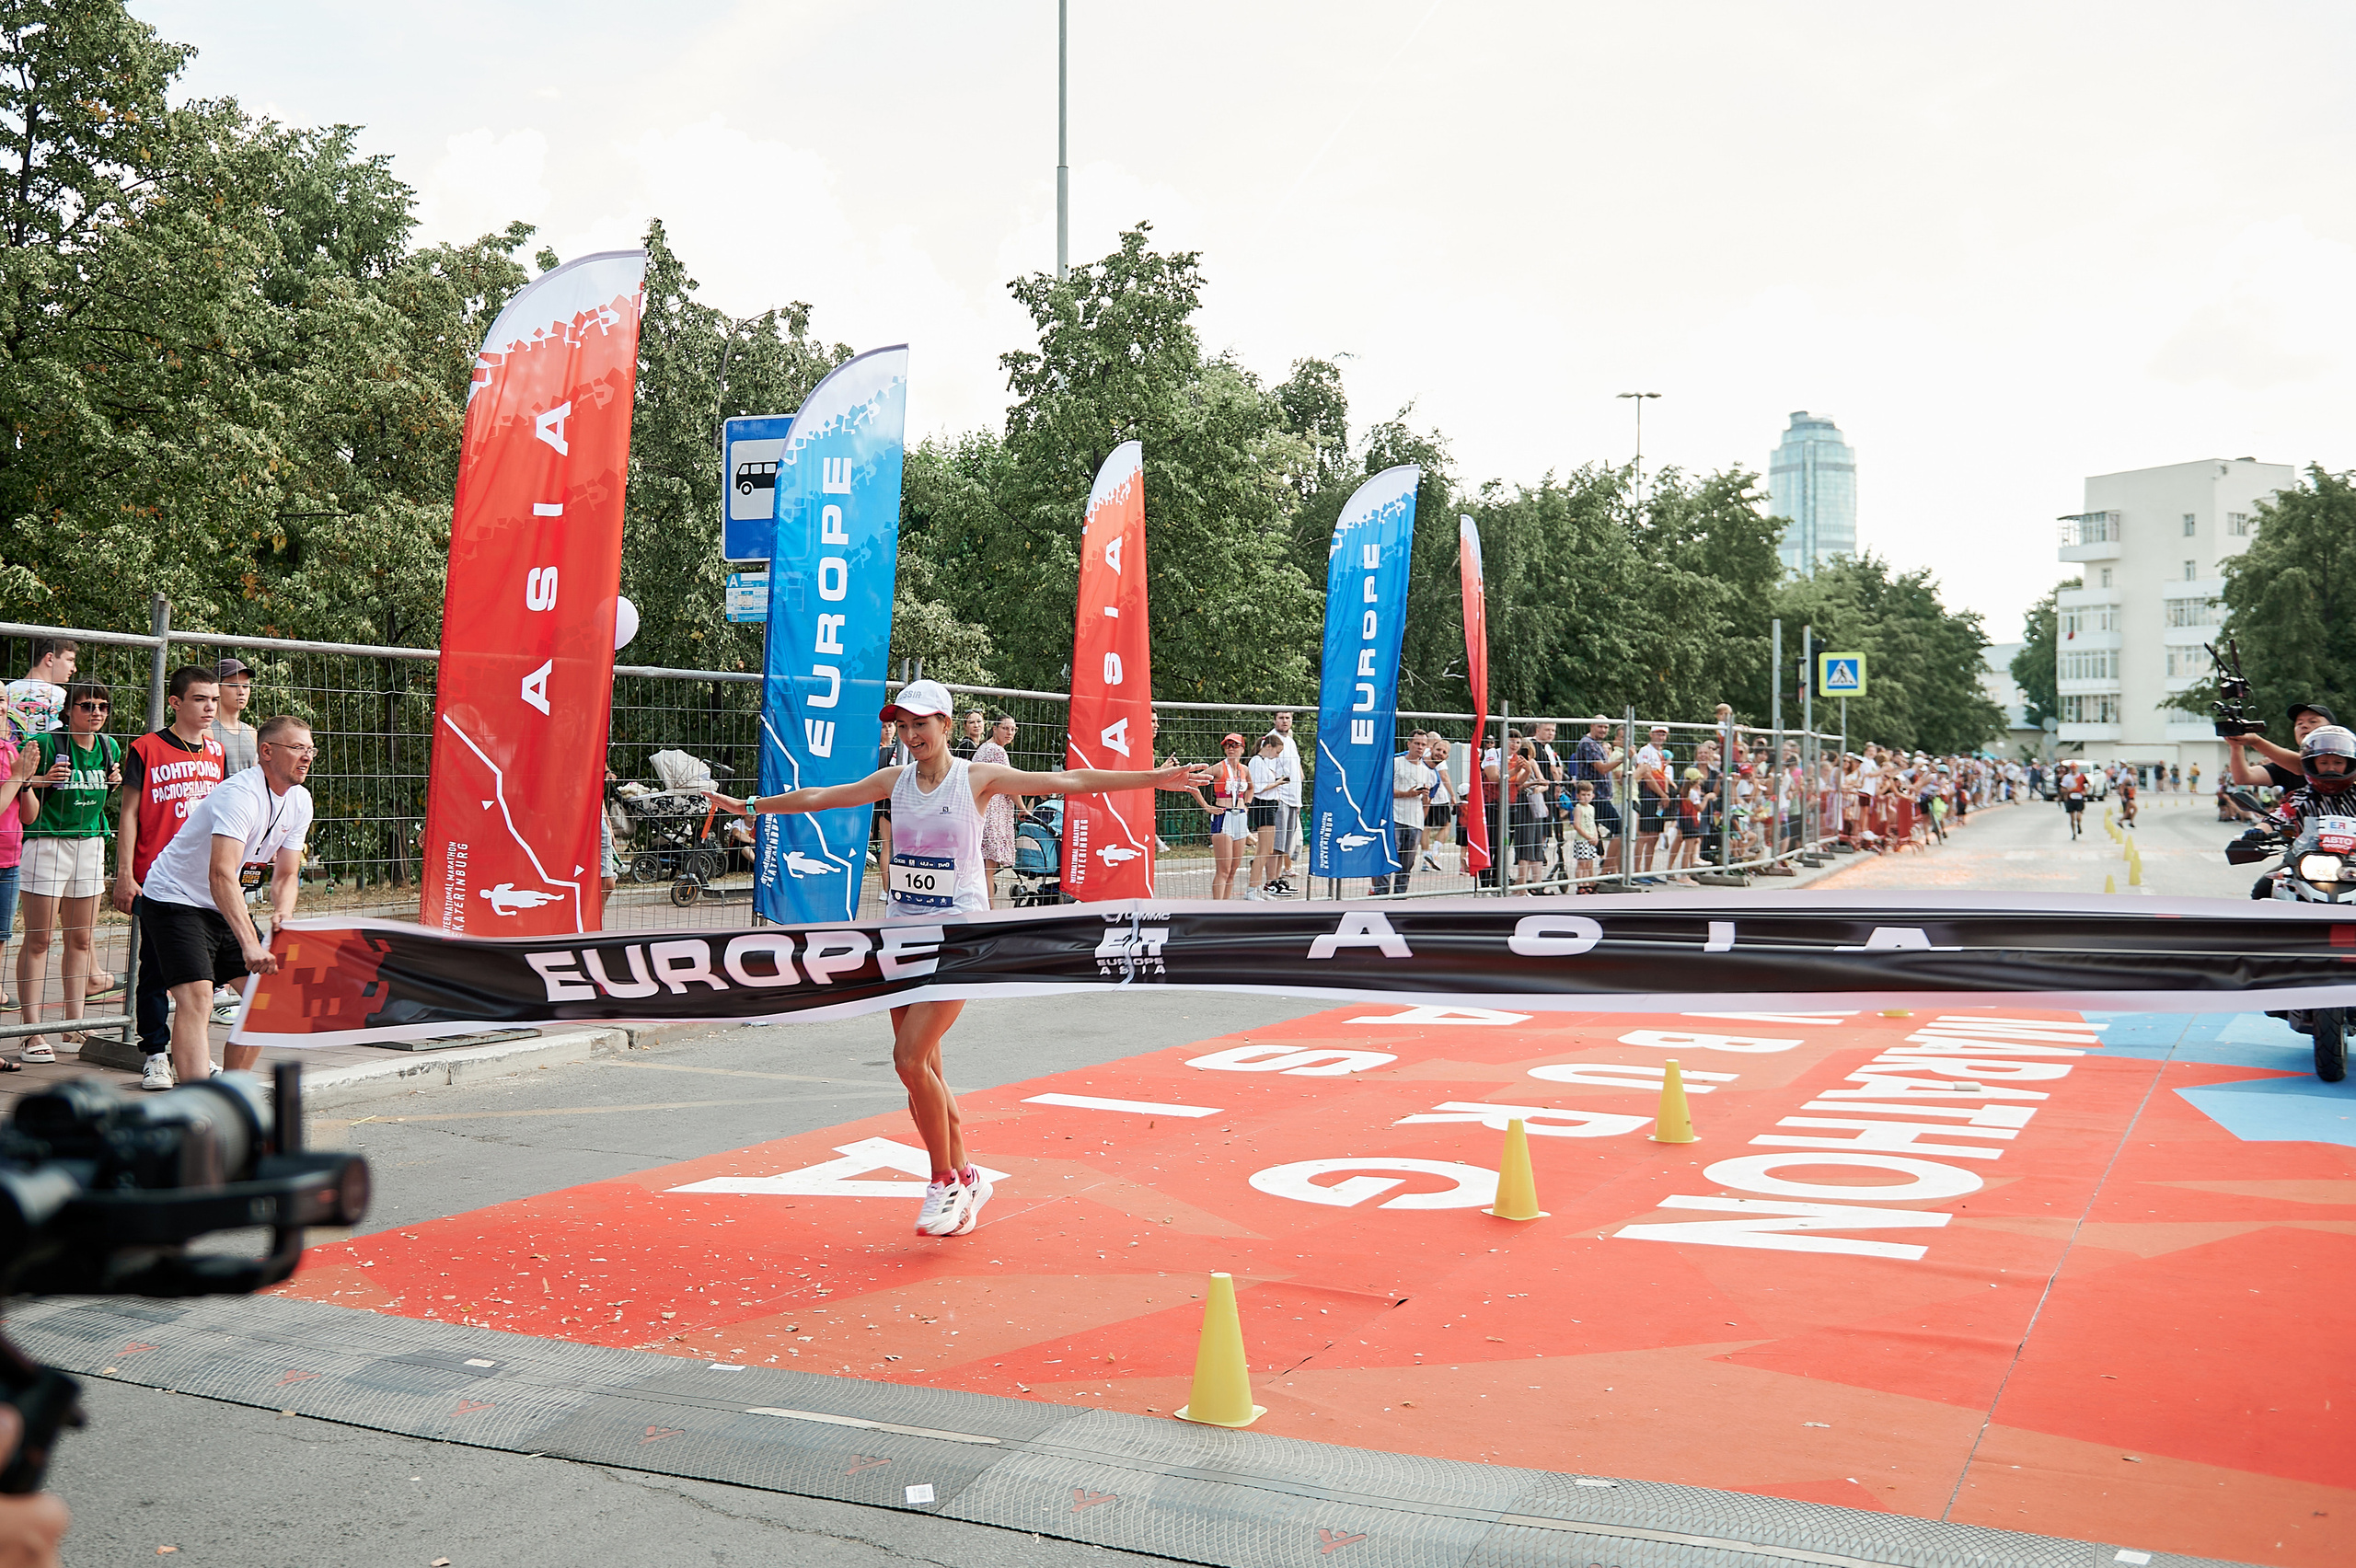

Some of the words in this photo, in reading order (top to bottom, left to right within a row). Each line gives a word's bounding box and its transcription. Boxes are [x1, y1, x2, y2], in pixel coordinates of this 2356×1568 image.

[521, 400, 572, 717] ASIA
[804, 456, 852, 758] EUROPE
[1101, 536, 1130, 758] ASIA
[1350, 543, 1381, 745] EUROPE
[900, 690, 922, 700] SSIA
[152, 780, 218, 804] РАСПОРЯДИТЕЛ
[446, 841, 456, 882] MARATHON
[1076, 819, 1089, 884] EKATERINBURG
[2322, 836, 2353, 846] АВТО
[443, 883, 455, 934] NTERNATIONAL
[452, 843, 468, 938] KATERINBURG
[905, 873, 936, 891] 160
[525, 925, 945, 1002] EUROPE
[1096, 957, 1165, 967] EUROPE
[1099, 964, 1166, 975] ASIA
[1611, 1015, 2110, 1262] MARATHON
